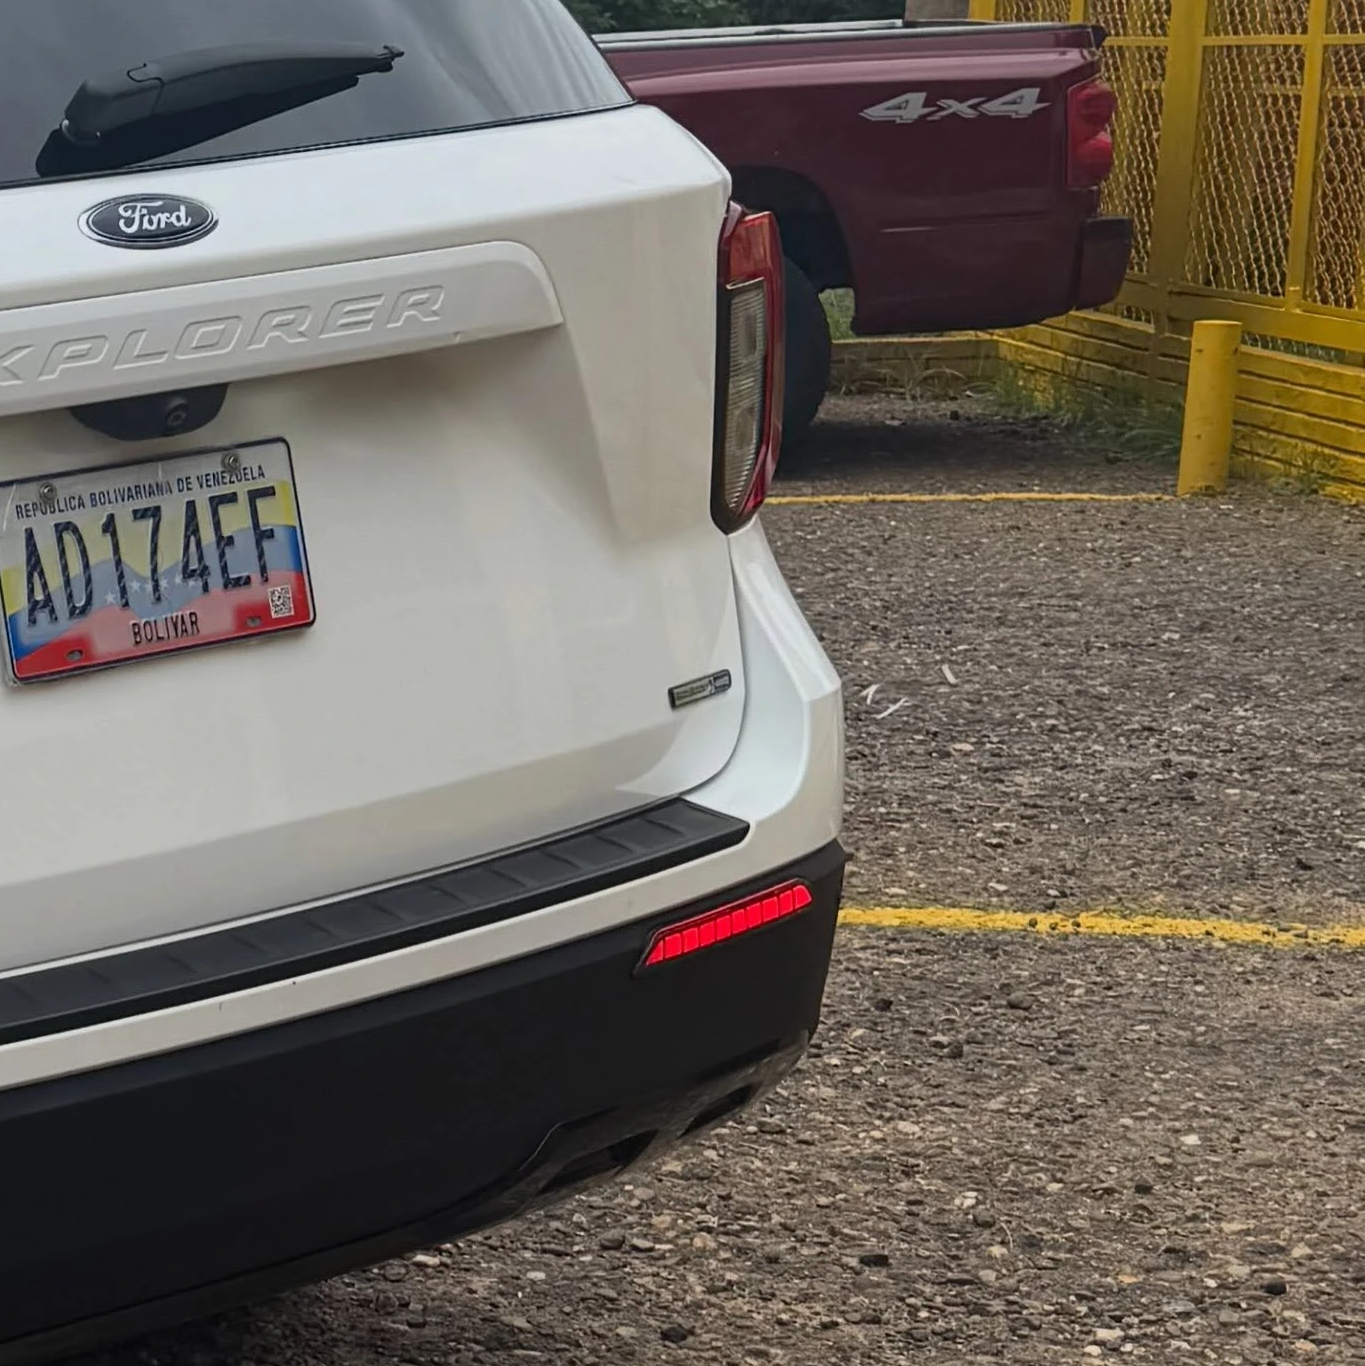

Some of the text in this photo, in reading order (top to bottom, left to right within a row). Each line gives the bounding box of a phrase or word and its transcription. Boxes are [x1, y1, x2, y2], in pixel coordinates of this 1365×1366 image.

[859, 88, 1052, 124] 4x4
[118, 201, 191, 233] Ford
[89, 480, 173, 508] BOLIVARIANA
[177, 476, 193, 493] DE
[196, 464, 266, 489] VENEZUELA
[25, 486, 276, 626] AD174EF
[131, 611, 200, 645] BOLIVAR
